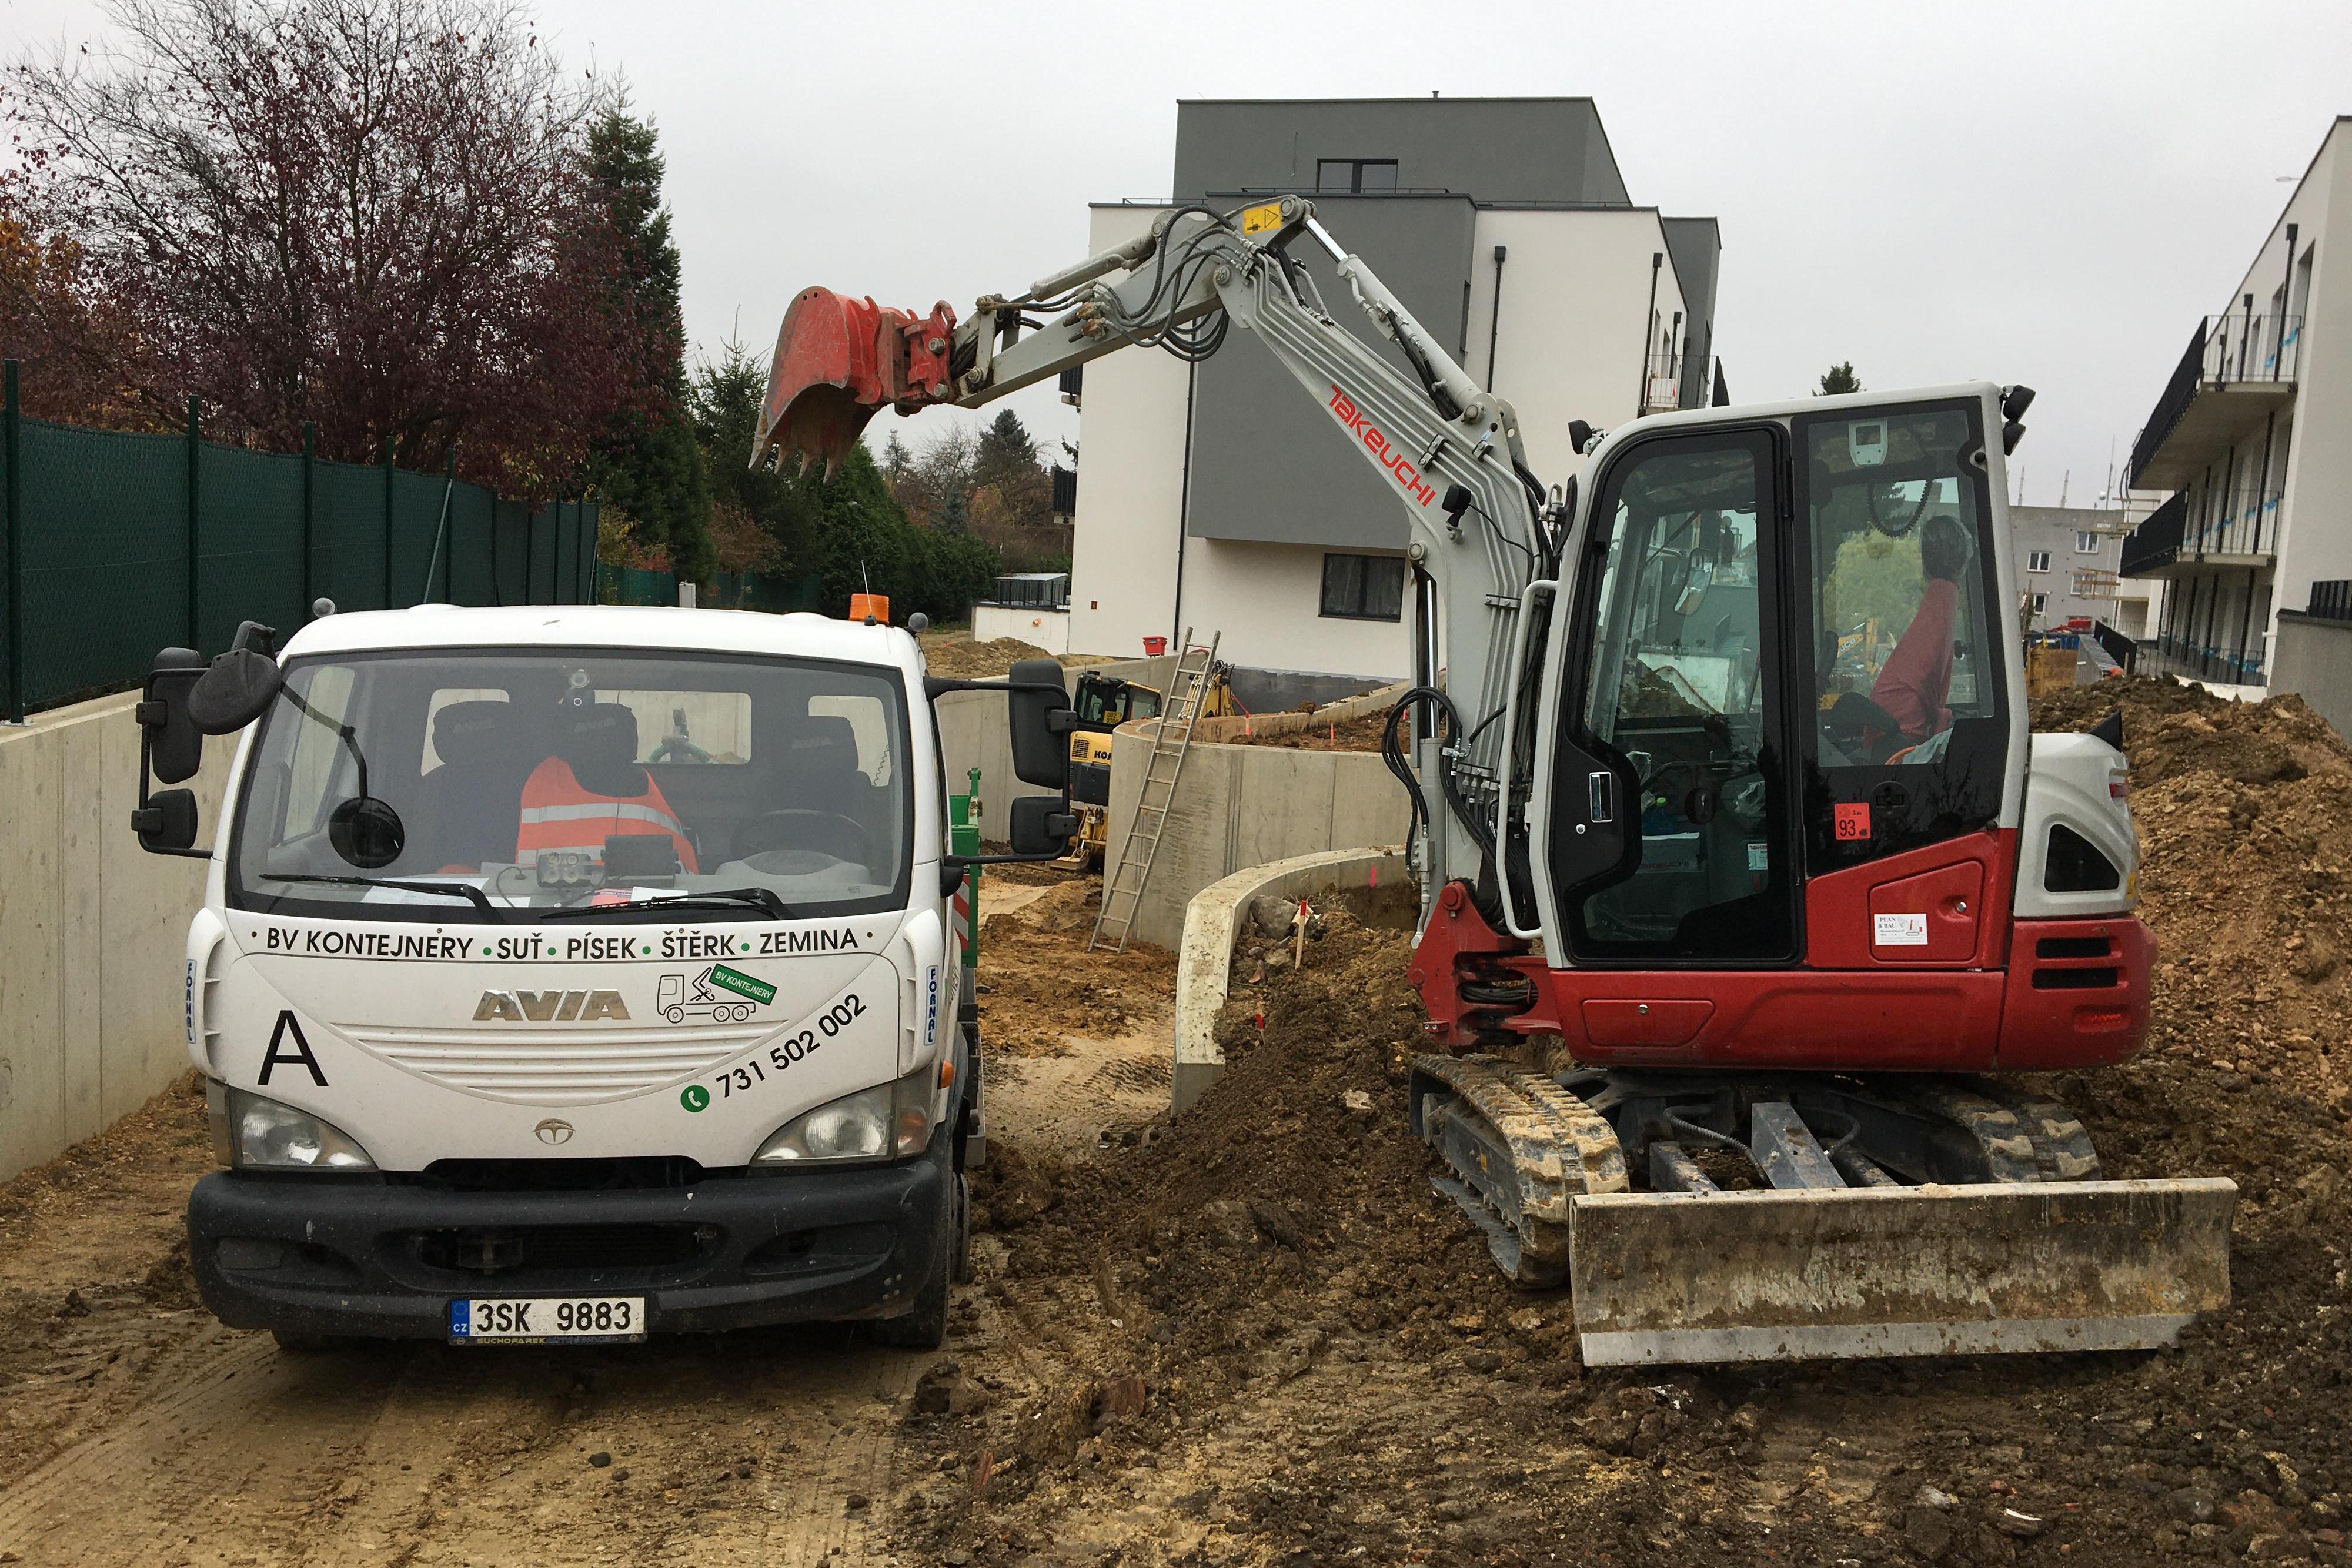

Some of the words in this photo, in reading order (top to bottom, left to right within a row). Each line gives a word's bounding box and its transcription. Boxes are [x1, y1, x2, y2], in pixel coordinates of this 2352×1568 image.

[1839, 820, 1856, 836] 93
[266, 927, 299, 950] BV
[306, 930, 474, 959] KONTEJNERY
[497, 932, 543, 959] SUŤ
[567, 932, 636, 959] PÍSEK
[661, 930, 736, 958] ŠTĚRK
[760, 928, 859, 954] ZEMINA
[716, 971, 727, 981] BV
[727, 975, 772, 999] KONTEJNERY
[472, 989, 632, 1021] AVIA
[928, 969, 937, 1042] FORNAL
[257, 1009, 329, 1087] A
[716, 1060, 766, 1098] 731
[770, 1030, 821, 1070] 502
[818, 994, 867, 1037] 002
[453, 1323, 467, 1333] CZ
[476, 1303, 532, 1332] 3SK
[557, 1302, 631, 1332] 9883
